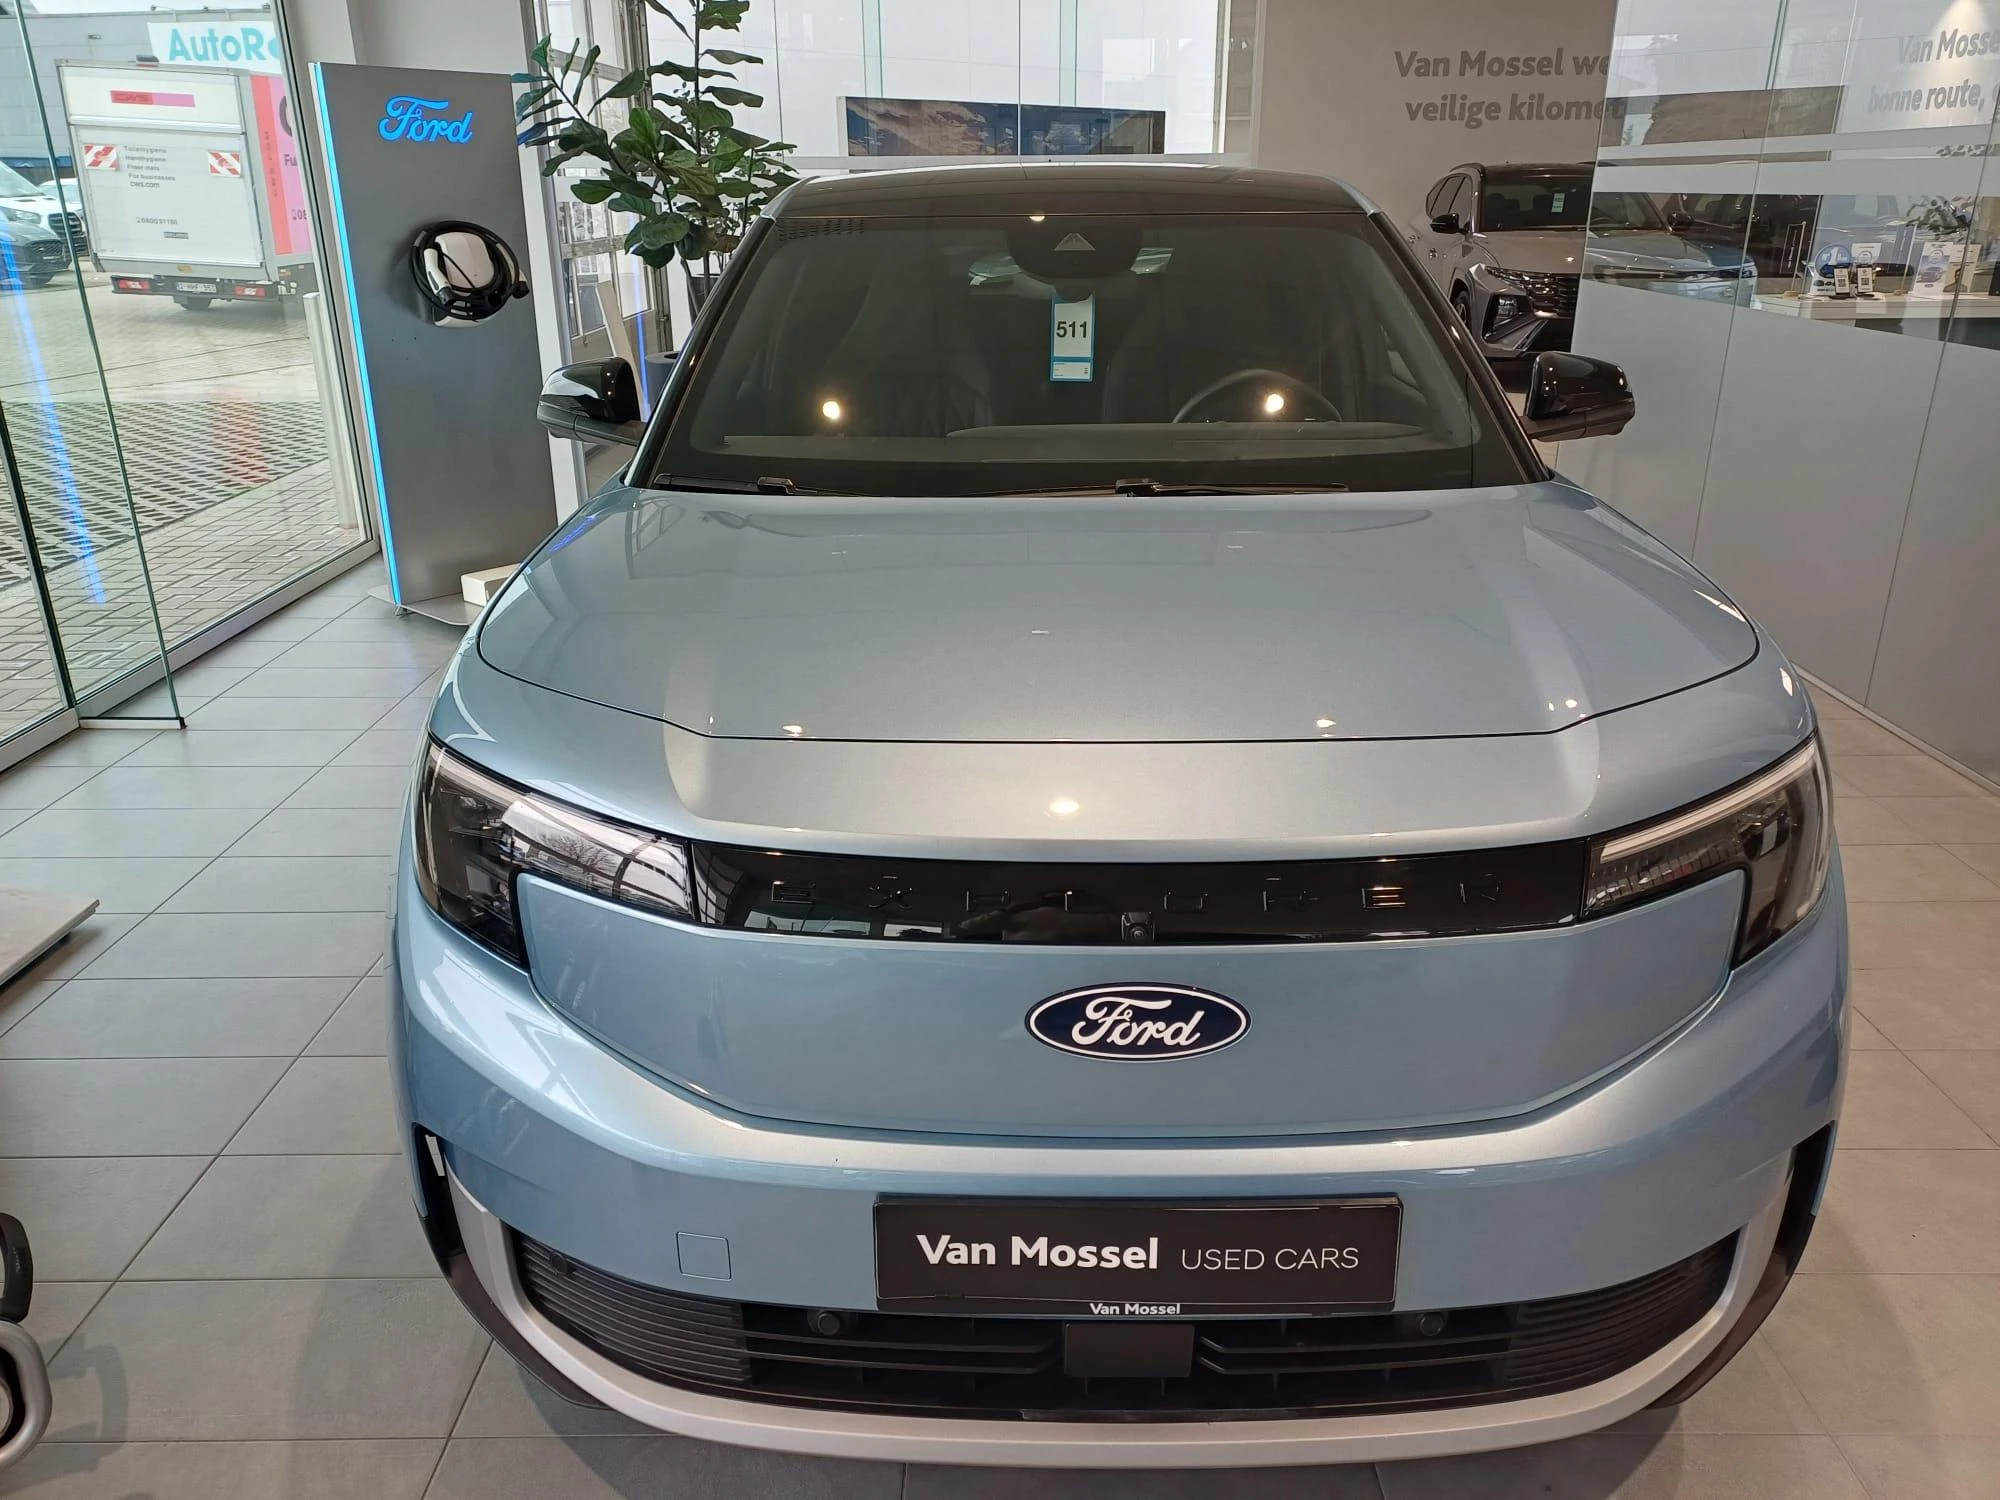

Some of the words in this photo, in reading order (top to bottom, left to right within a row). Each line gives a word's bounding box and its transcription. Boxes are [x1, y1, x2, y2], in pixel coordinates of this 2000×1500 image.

[1394, 51, 1450, 77] Van
[1459, 48, 1564, 77] Mossel
[1405, 94, 1501, 129] veilige
[1868, 85, 1923, 113] bonne
[1925, 79, 1985, 112] route,
[379, 95, 473, 142] Ford
[1056, 321, 1087, 338] 511
[1072, 996, 1205, 1046] Ford
[916, 1234, 996, 1265] Van
[1011, 1235, 1159, 1270] Mossel
[1182, 1249, 1265, 1270] USED
[1275, 1247, 1359, 1270] CARS
[1089, 1302, 1120, 1315] Van
[1124, 1303, 1181, 1316] Mossel
